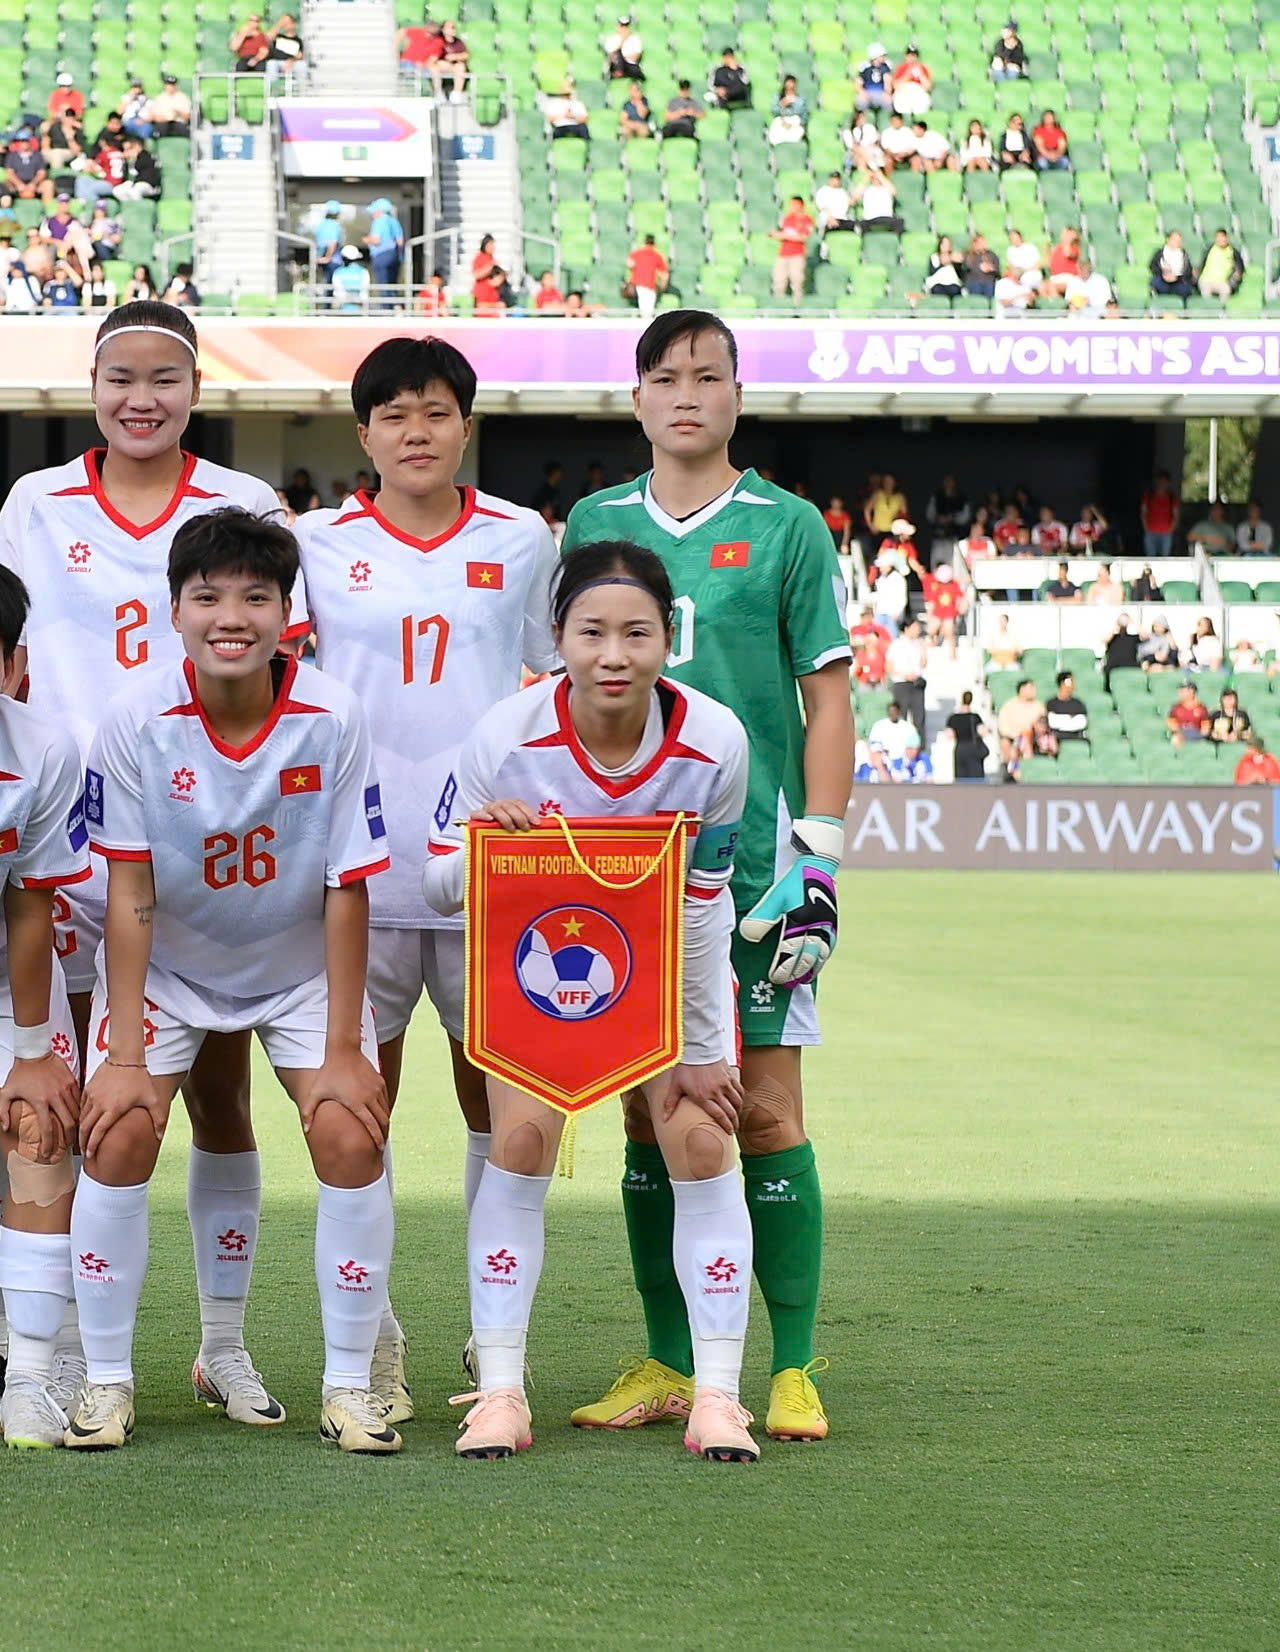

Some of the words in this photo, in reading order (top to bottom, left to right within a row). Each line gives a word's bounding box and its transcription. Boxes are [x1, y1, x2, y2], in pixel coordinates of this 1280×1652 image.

[856, 335, 955, 376] AFC
[963, 336, 1192, 376] WOMEN'S
[116, 598, 148, 670] 2
[402, 614, 450, 685] 17
[849, 799, 945, 853] AR
[975, 800, 1265, 856] AIRWAYS
[204, 824, 276, 890] 26
[491, 855, 536, 874] VIETNAM
[556, 991, 592, 1005] VFF
